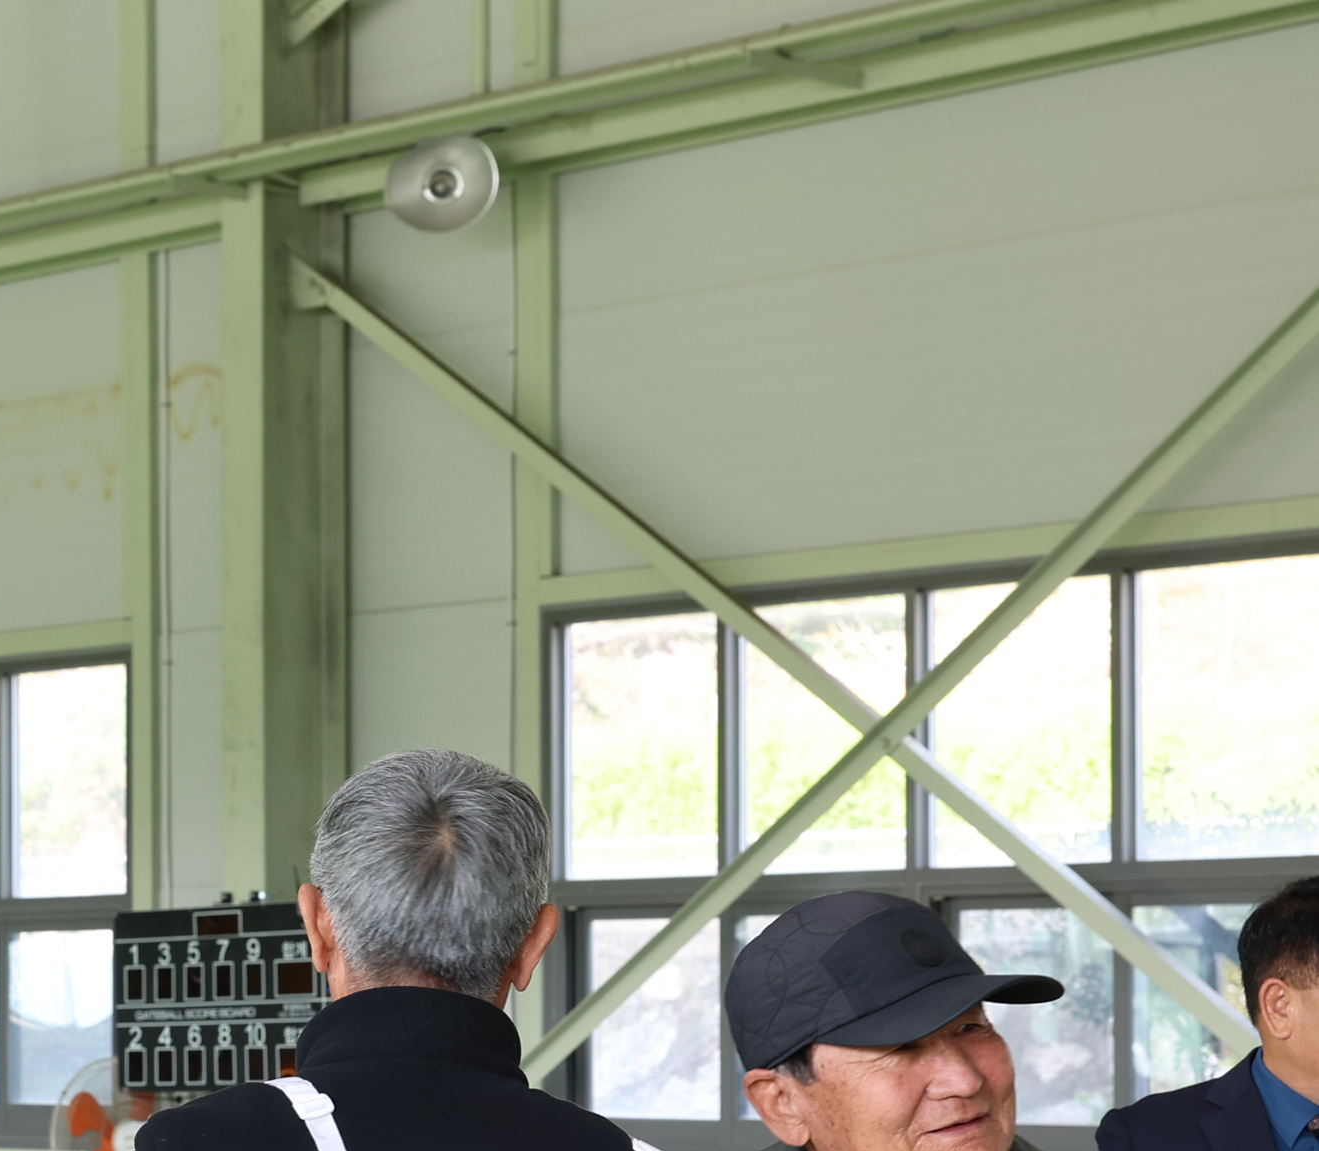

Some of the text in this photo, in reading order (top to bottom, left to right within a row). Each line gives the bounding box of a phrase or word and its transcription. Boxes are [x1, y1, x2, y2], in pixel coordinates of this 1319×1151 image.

[129, 944, 140, 965] 1
[158, 942, 172, 965] 3
[187, 941, 201, 963] 5
[216, 939, 230, 961] 7
[246, 938, 261, 961] 9
[129, 1026, 143, 1048] 2
[158, 1026, 172, 1047] 4
[187, 1024, 202, 1047] 6
[218, 1023, 232, 1046] 8
[244, 1023, 266, 1046] 10
